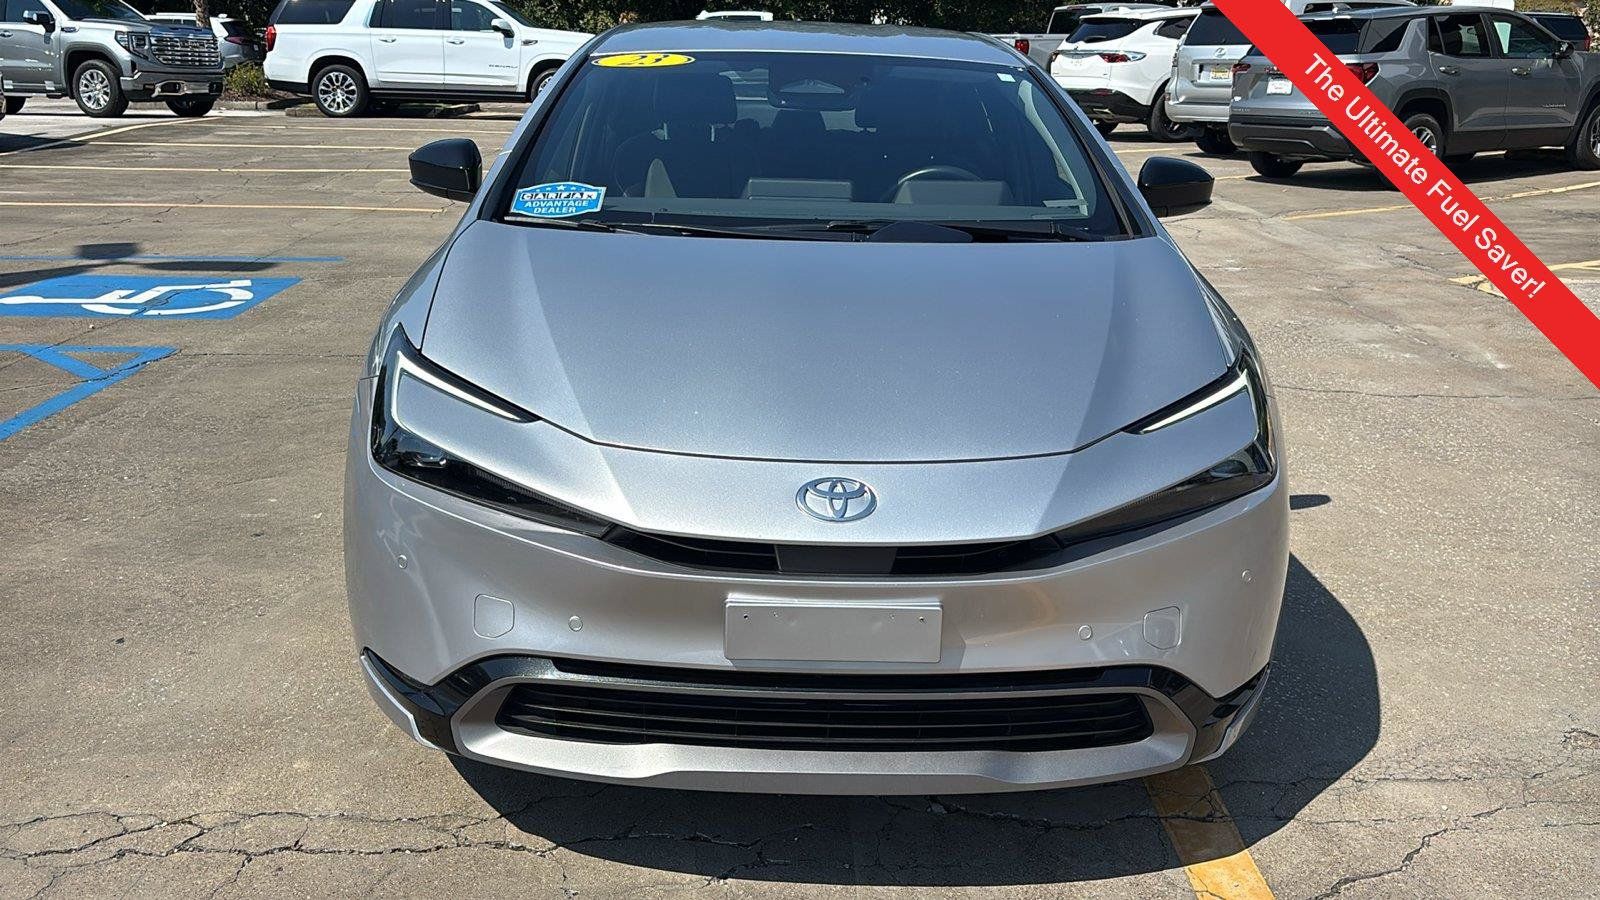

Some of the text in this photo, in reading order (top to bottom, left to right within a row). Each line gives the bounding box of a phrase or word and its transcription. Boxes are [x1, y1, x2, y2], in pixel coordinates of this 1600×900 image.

[520, 191, 598, 201] CARFAX
[524, 200, 589, 208] ADVANTAGE
[533, 206, 576, 214] DEALER
